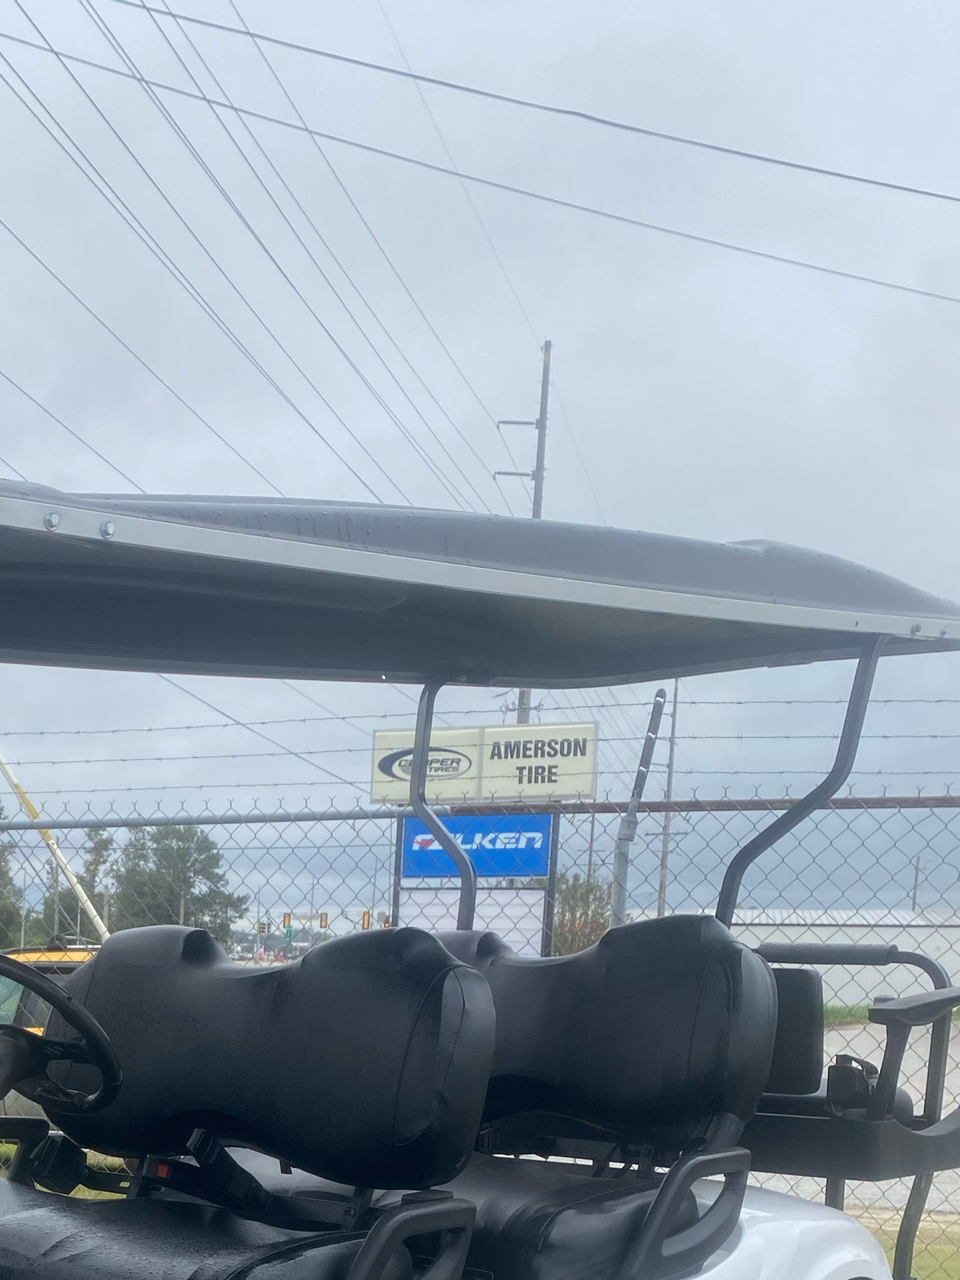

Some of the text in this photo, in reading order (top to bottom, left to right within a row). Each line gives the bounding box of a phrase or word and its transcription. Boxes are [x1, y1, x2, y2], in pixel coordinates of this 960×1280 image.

[490, 738, 587, 760] AMERSON
[398, 757, 461, 767] CPER
[516, 765, 558, 784] TIRE
